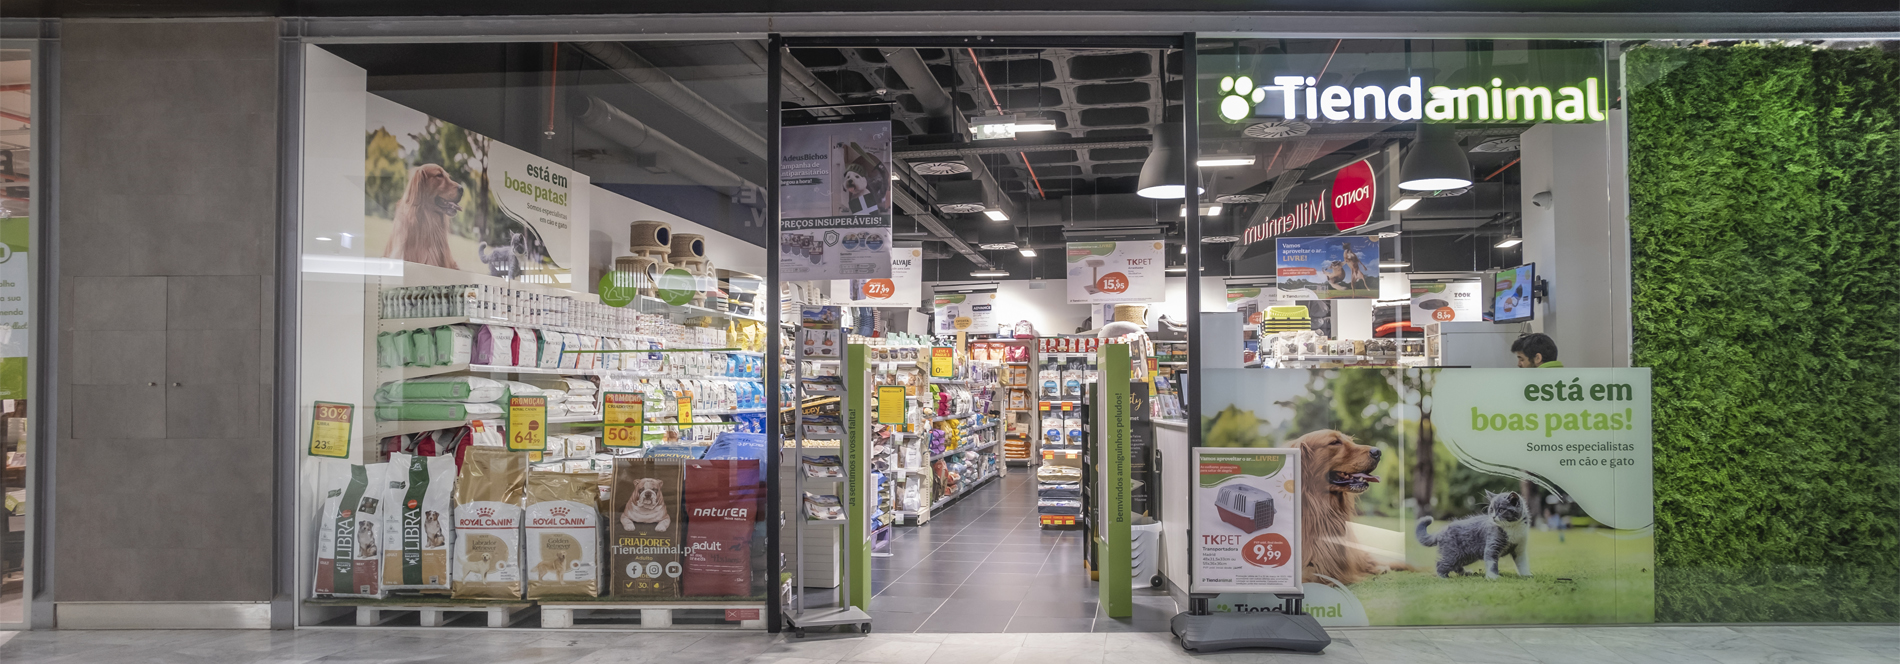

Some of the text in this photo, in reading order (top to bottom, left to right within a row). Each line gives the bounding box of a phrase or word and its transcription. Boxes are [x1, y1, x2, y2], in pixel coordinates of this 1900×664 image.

[1274, 76, 1606, 122] Tiendanimal
[526, 163, 568, 189] está em
[504, 171, 568, 207] boas patas!
[526, 202, 568, 220] Somos especialistas
[558, 221, 568, 230] gato
[781, 216, 882, 229] PREÇOS INSUPERÁVEIS!
[892, 259, 911, 267] ALVAJE
[1127, 258, 1152, 266] TKPET
[1523, 376, 1632, 402] está em
[319, 407, 347, 420] 30%
[802, 406, 821, 415] uppy
[1470, 406, 1633, 438] boas patas!
[1526, 441, 1635, 454] Somos especialistas
[1114, 392, 1125, 523] Bemvindos amiguinhos peludos!
[1559, 456, 1635, 468] em cão e gato
[459, 518, 512, 526] ROYAL CANIN
[404, 508, 421, 551] LIBRA
[336, 517, 354, 560] LIBRA
[618, 537, 671, 547] CRIADORES
[1202, 534, 1242, 545] TKPET
[611, 543, 697, 557] Tiendanimal.pt
[693, 541, 722, 551] adult
